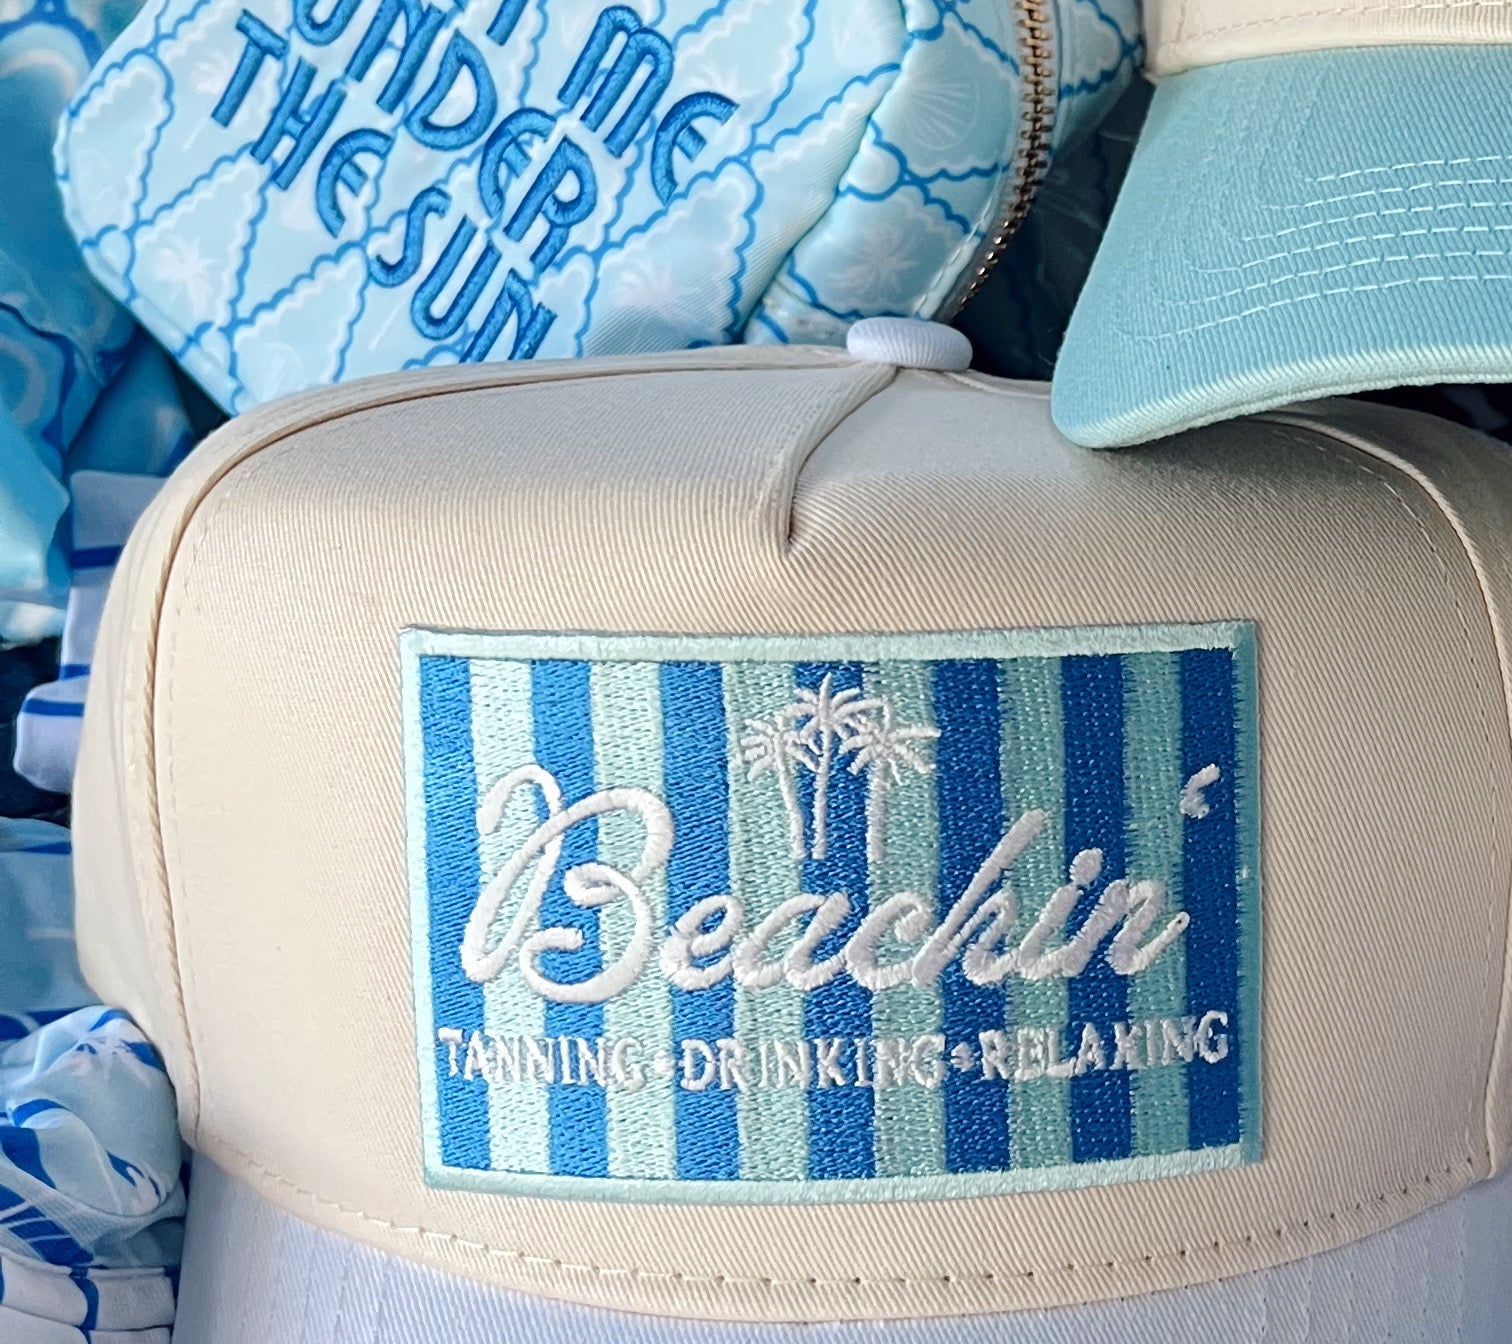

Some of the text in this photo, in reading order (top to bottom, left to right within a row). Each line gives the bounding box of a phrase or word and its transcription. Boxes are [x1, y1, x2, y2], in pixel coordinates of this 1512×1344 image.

[211, 8, 558, 364] THE SUN
[558, 4, 740, 206] ME
